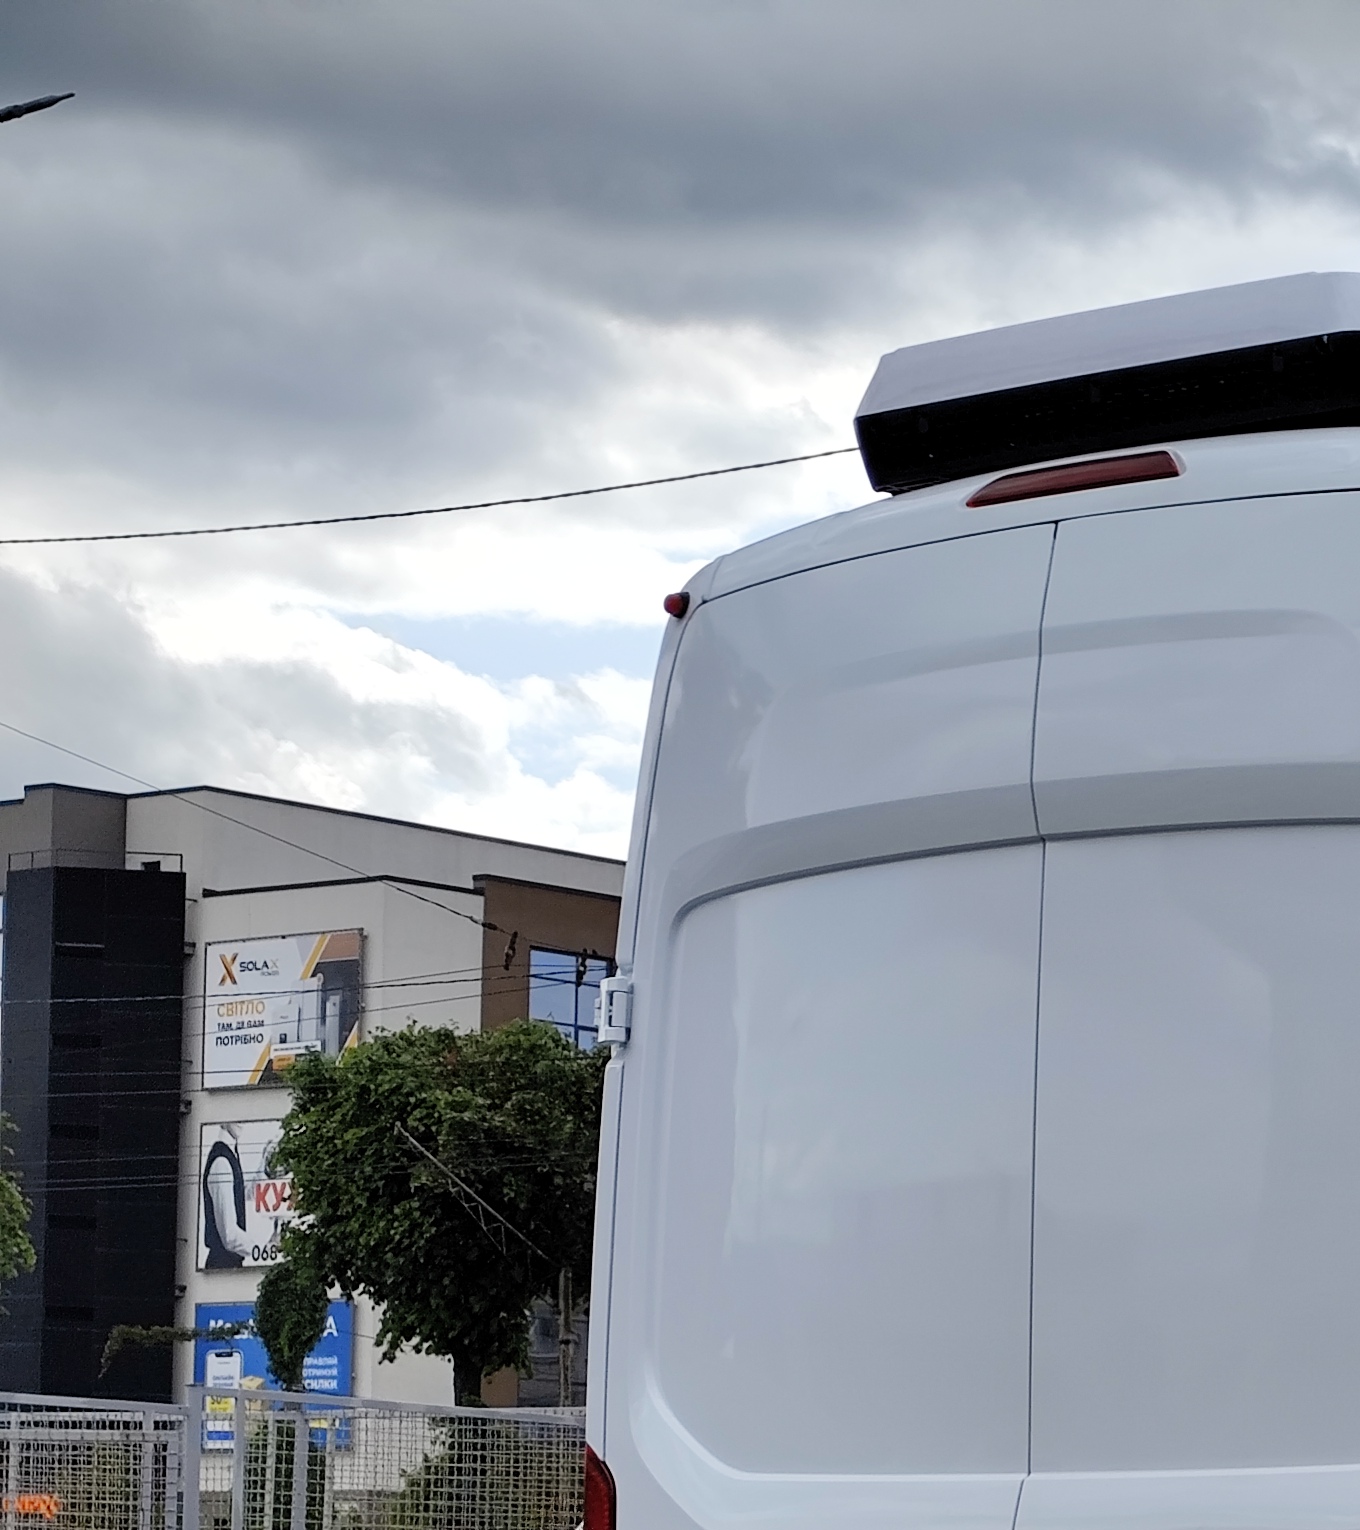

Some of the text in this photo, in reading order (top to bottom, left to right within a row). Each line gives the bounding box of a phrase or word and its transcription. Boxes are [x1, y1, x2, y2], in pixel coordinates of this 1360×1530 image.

[217, 1001, 265, 1017] СВІТЛО
[215, 1033, 264, 1046] ПОТРІБНО
[303, 1379, 338, 1390] СИЛКИ
